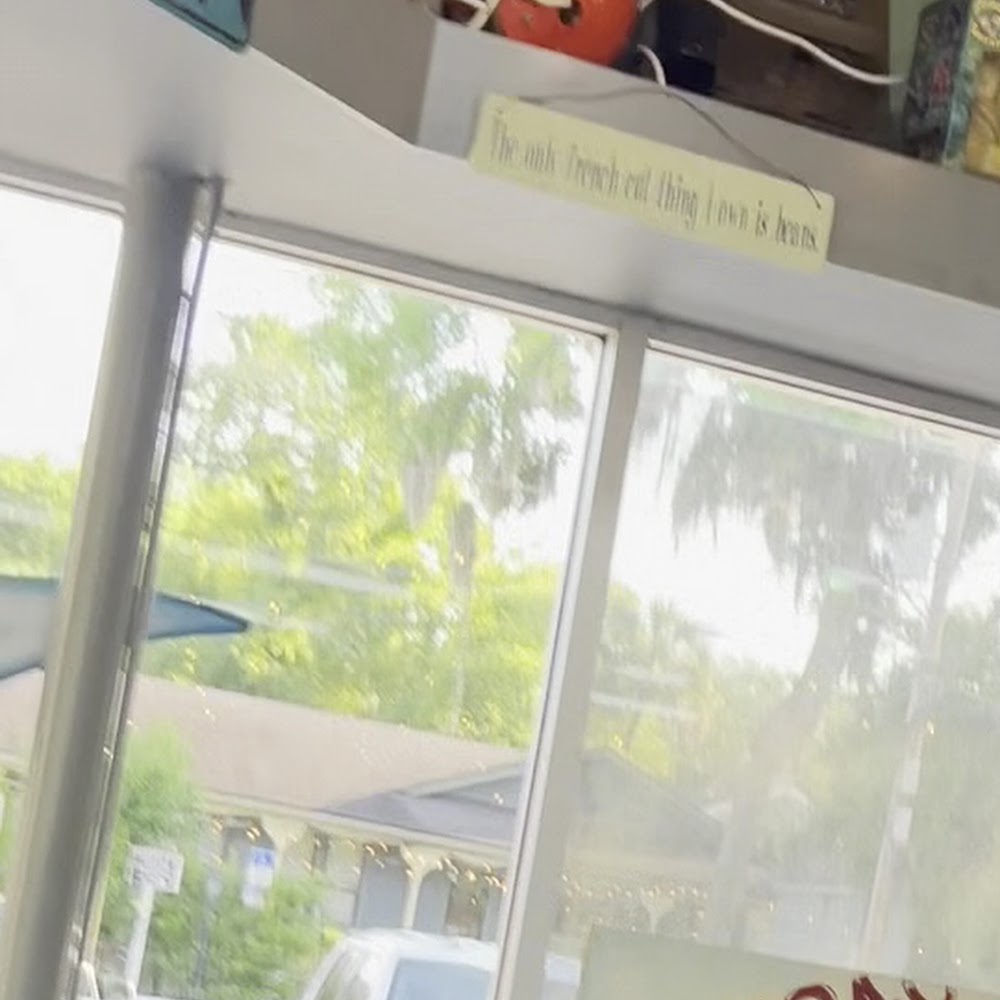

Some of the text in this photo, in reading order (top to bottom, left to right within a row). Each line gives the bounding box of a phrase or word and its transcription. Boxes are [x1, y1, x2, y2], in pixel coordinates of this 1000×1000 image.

[657, 167, 700, 231] thing
[717, 198, 749, 230] own
[754, 200, 769, 237] is
